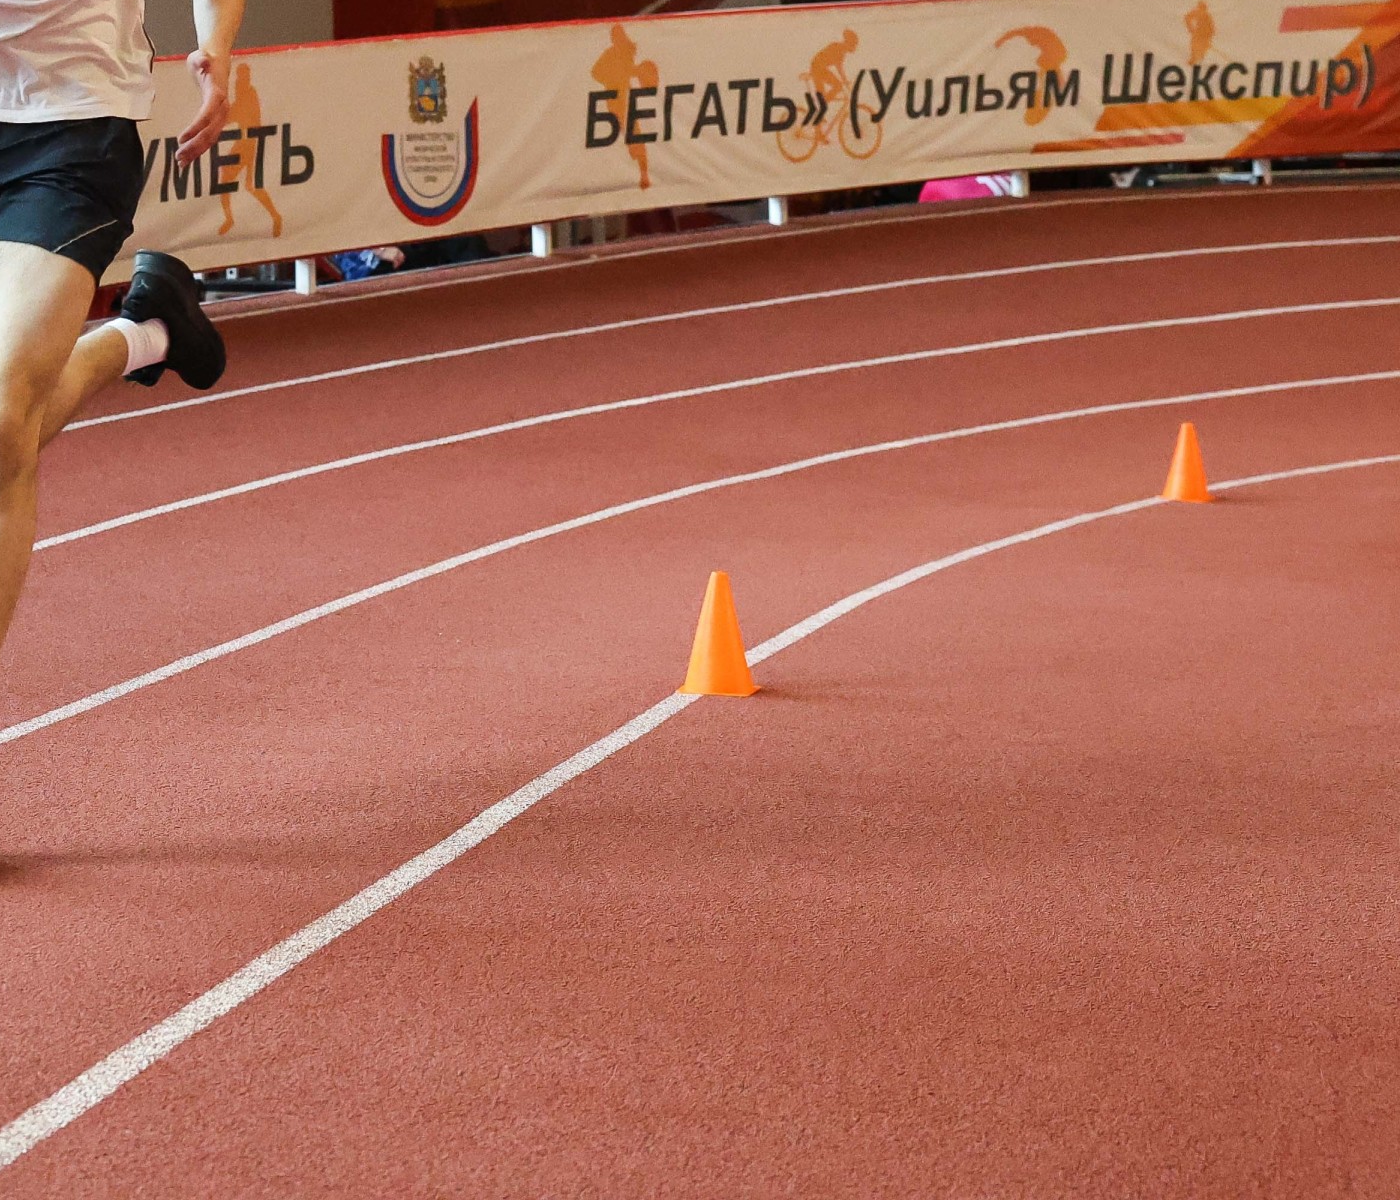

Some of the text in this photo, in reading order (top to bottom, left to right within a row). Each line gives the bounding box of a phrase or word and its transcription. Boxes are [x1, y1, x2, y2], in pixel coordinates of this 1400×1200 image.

[584, 74, 828, 150] БЕГАТЬ»
[848, 64, 1080, 139] (Уильям
[1100, 44, 1375, 107] Шекспир)
